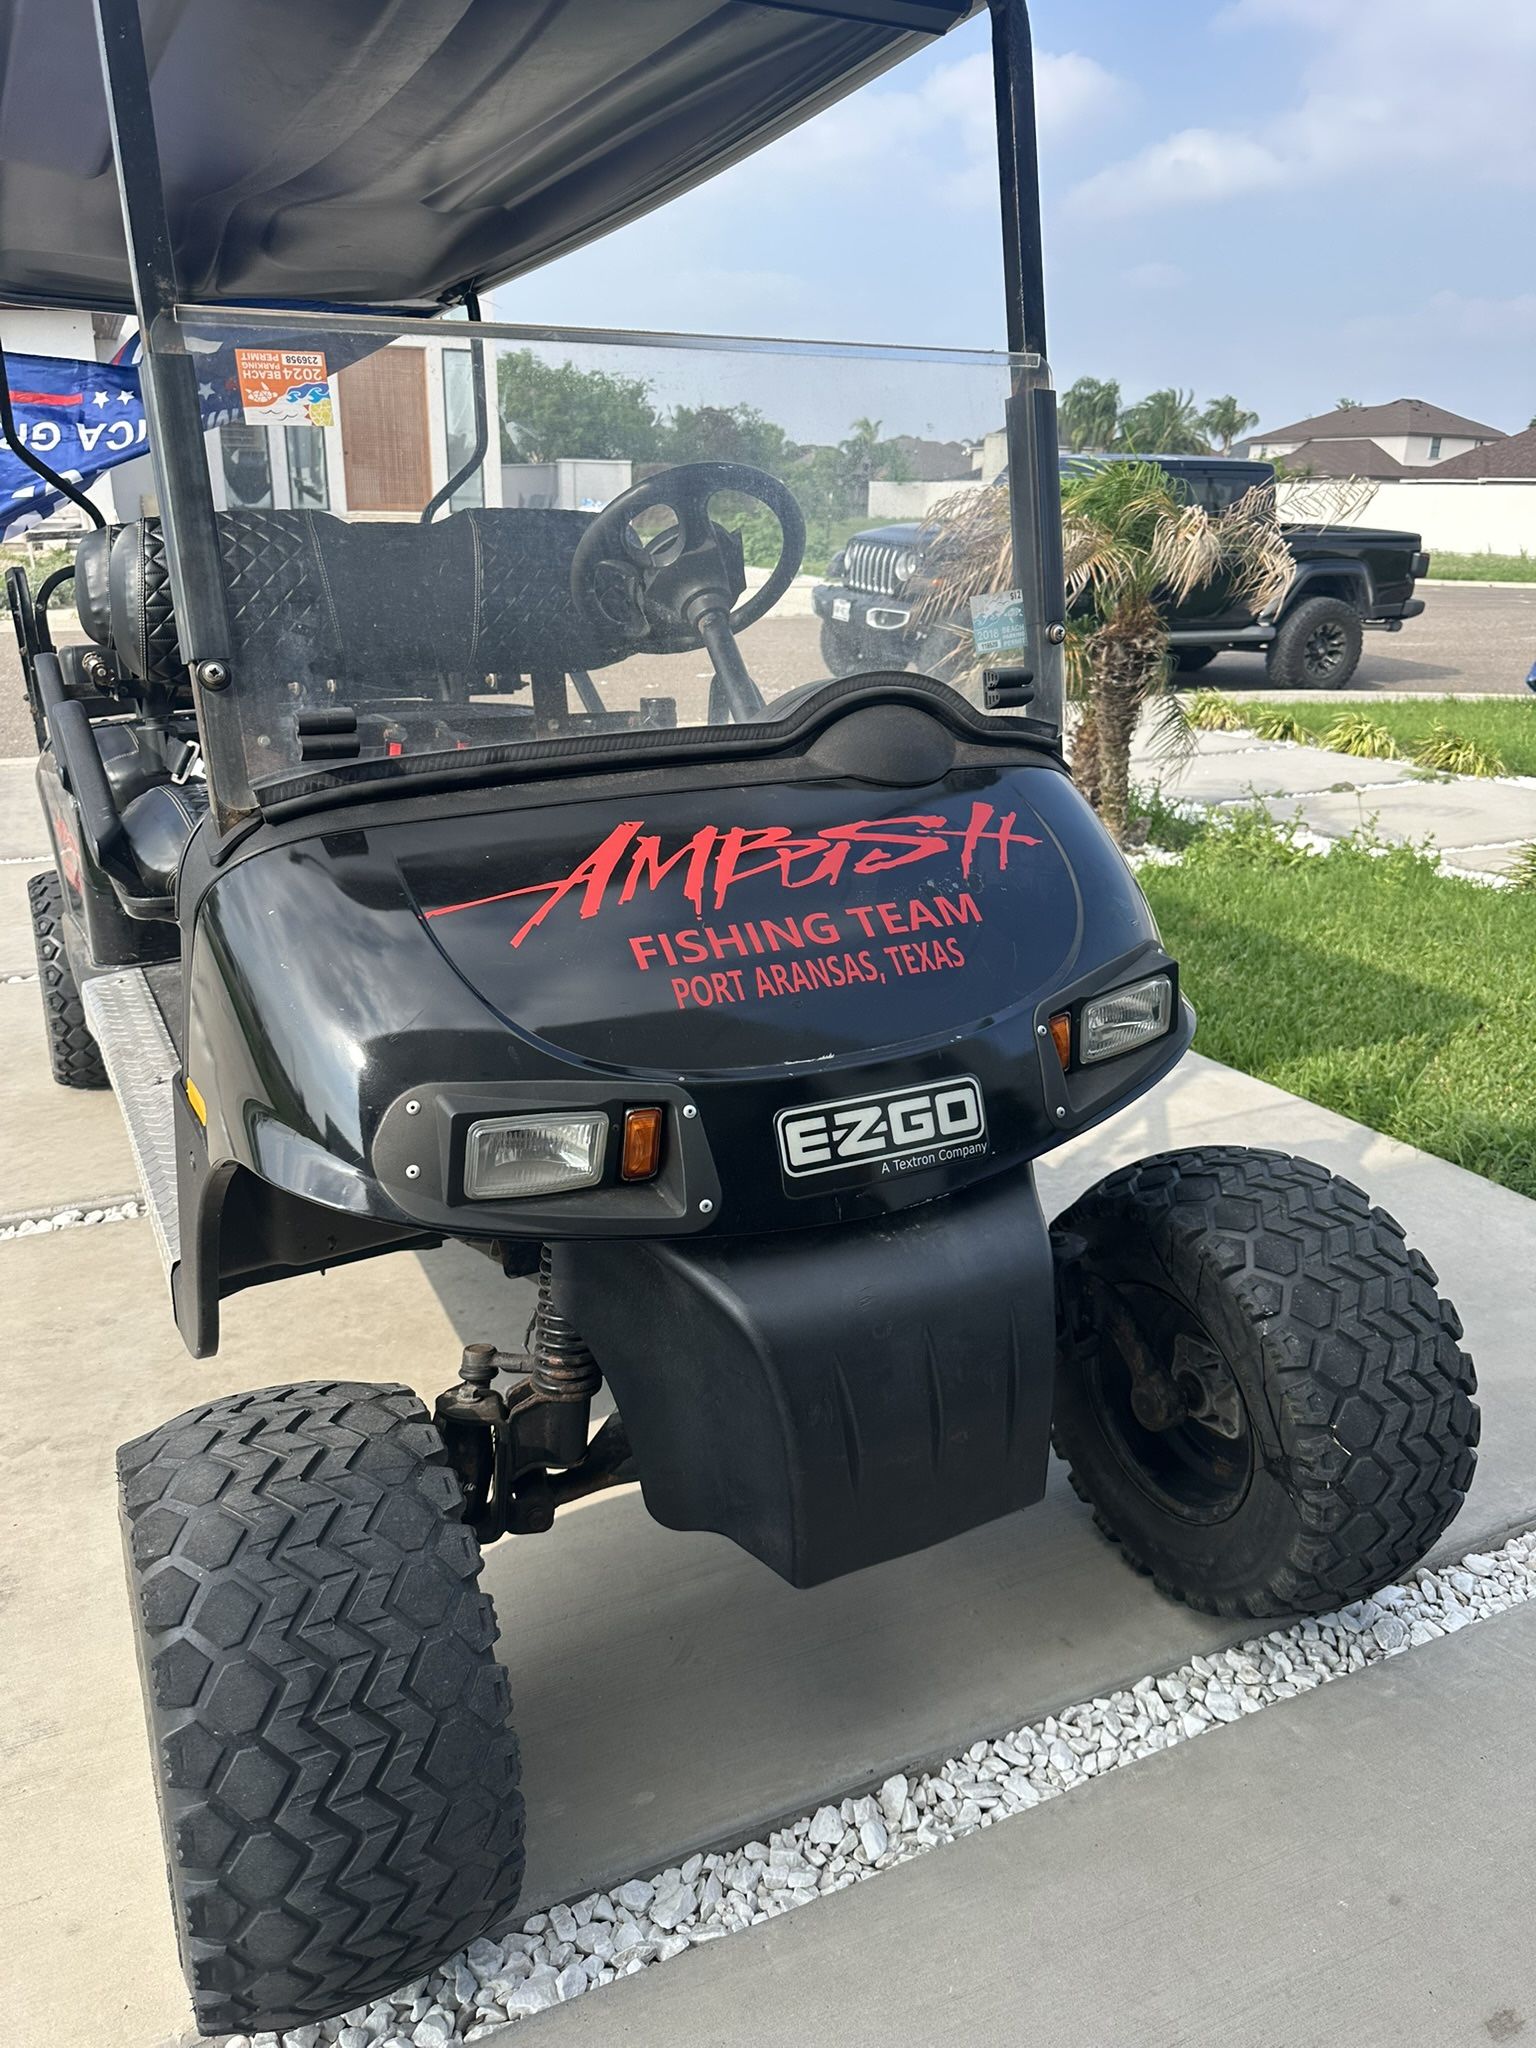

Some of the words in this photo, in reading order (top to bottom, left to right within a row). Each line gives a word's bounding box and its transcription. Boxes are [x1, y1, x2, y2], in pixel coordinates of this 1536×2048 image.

[241, 353, 279, 362] PERMIT
[286, 355, 318, 364] 236958
[242, 362, 280, 370] PARKING
[243, 370, 281, 380] BEACH
[282, 368, 322, 380] 2024
[425, 801, 1043, 948] AMBUSH
[629, 912, 841, 971] FISHING
[844, 893, 983, 938] TEAM
[671, 969, 746, 1010] PORT
[756, 950, 887, 999] ARANSAS,
[883, 937, 966, 976] TEXAS
[881, 1162, 891, 1174] A
[893, 1154, 936, 1170] Textron
[938, 1142, 988, 1160] Company
